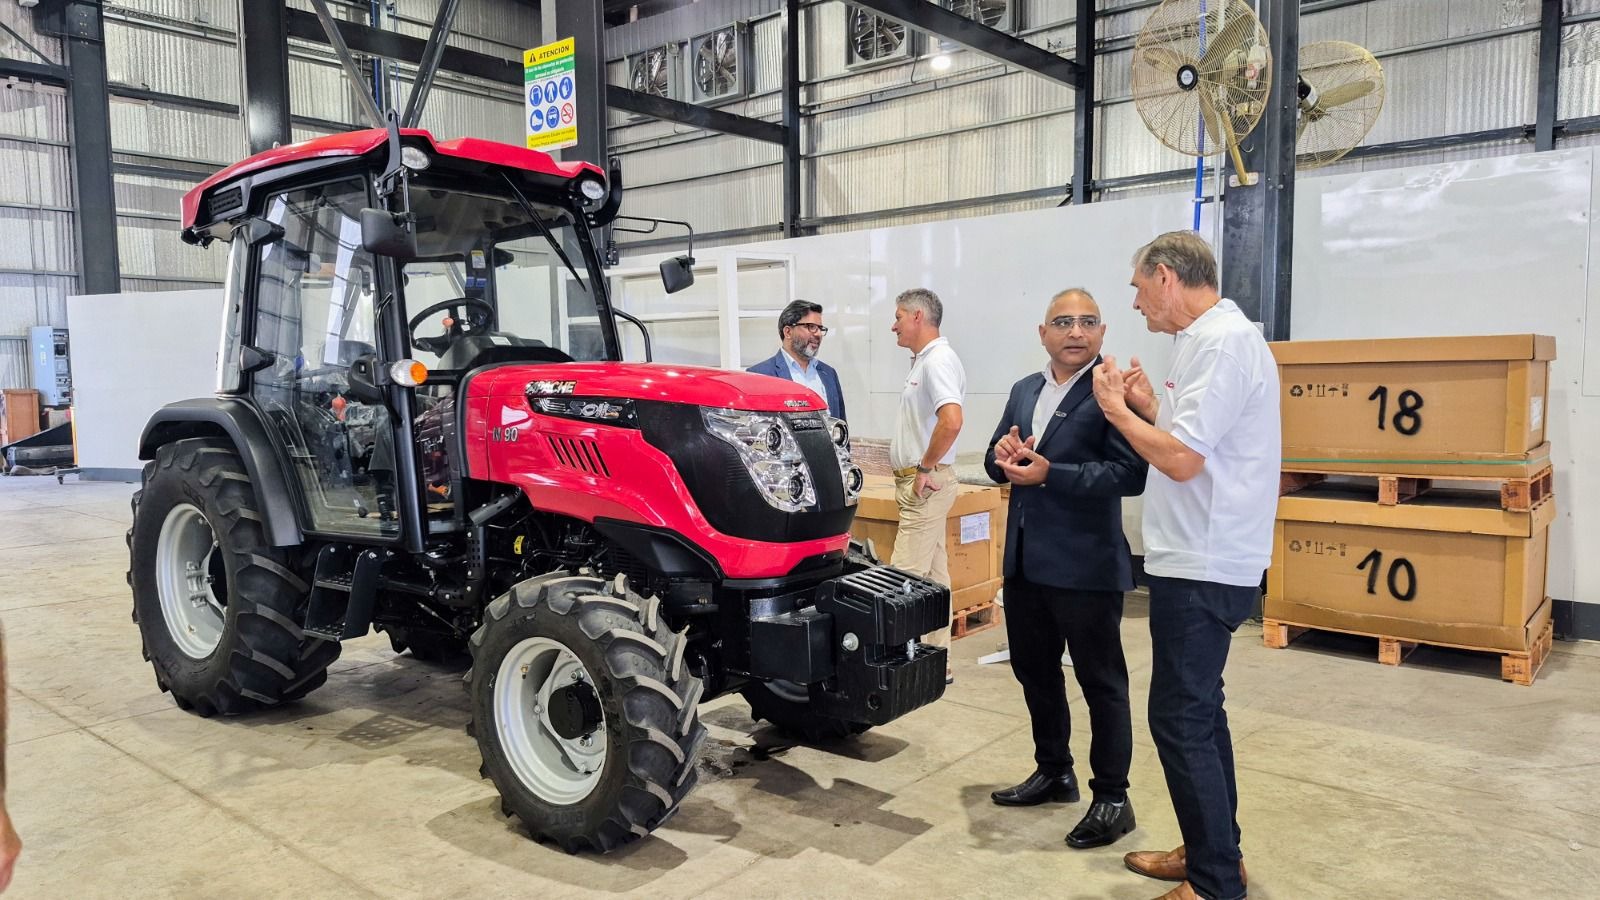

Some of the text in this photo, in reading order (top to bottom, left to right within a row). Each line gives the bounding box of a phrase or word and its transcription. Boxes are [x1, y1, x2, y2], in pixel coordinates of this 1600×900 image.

[525, 380, 576, 396] APACHE
[1368, 385, 1424, 436] 18
[504, 427, 518, 442] 90
[1356, 549, 1417, 602] 10
